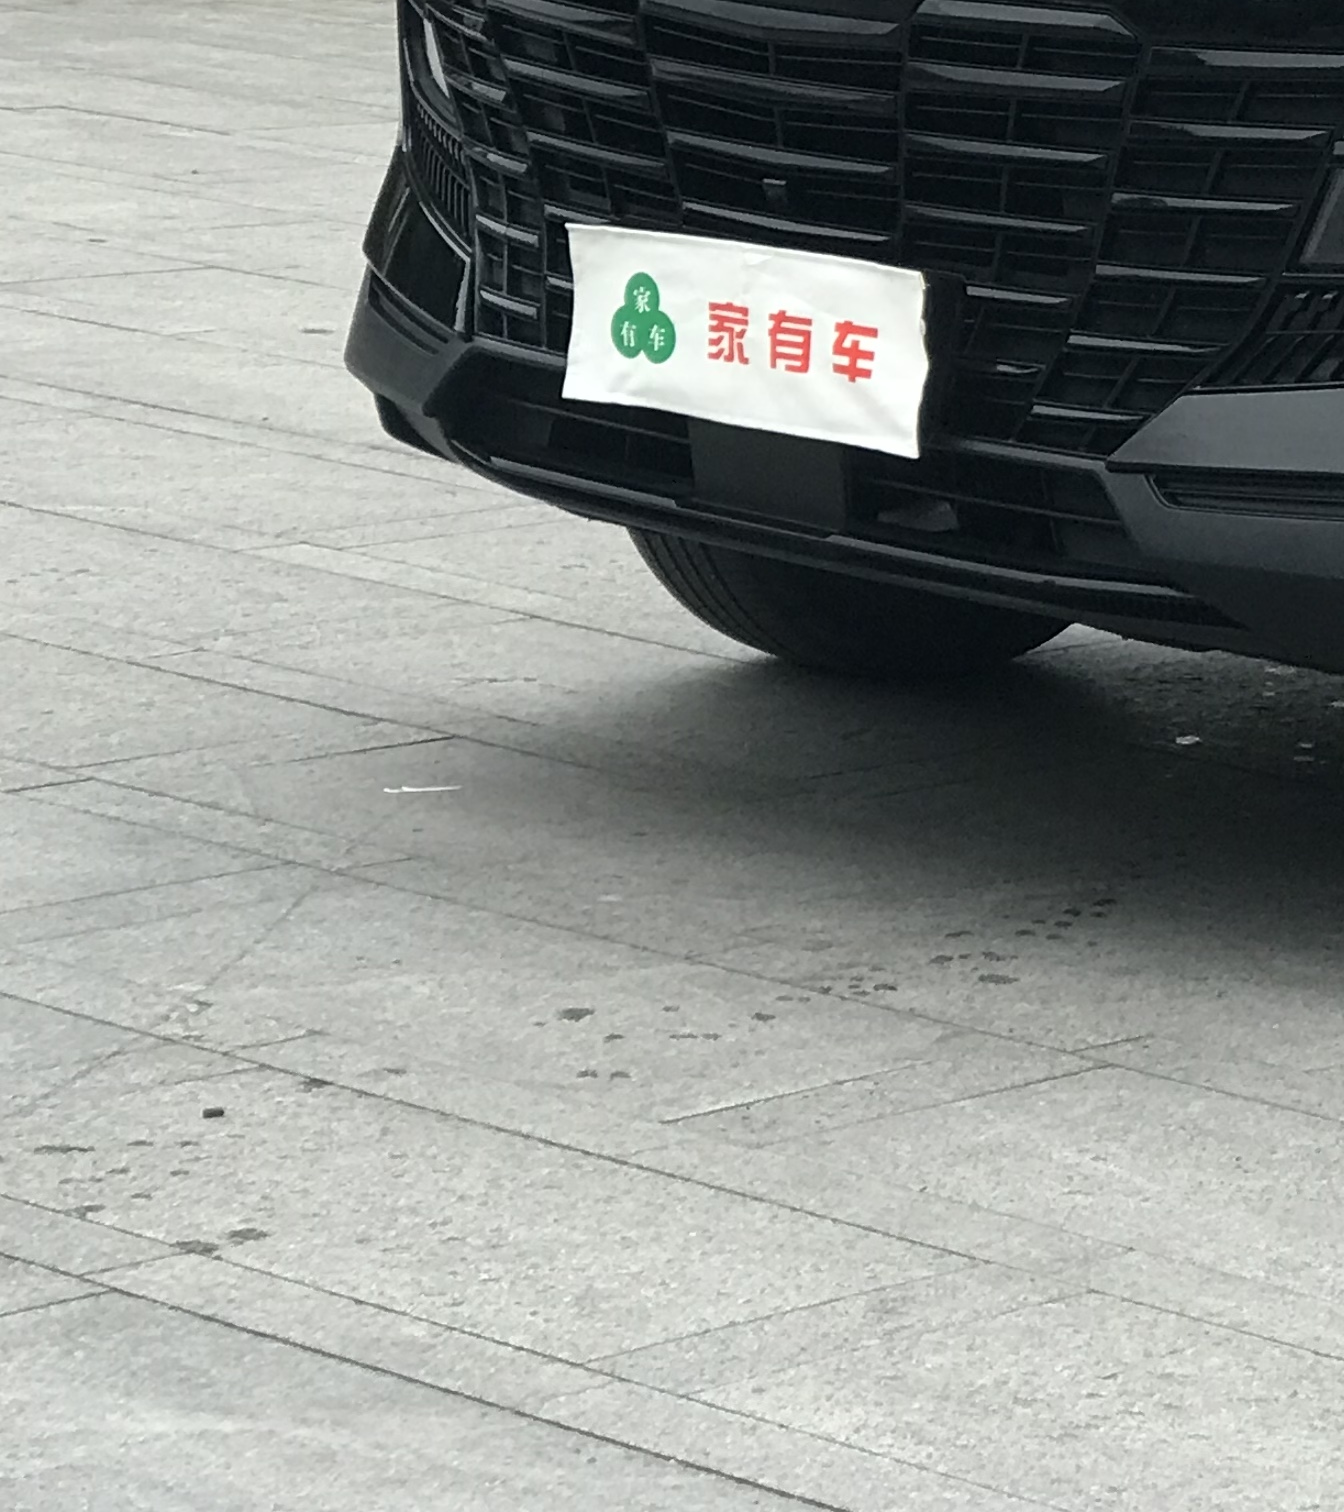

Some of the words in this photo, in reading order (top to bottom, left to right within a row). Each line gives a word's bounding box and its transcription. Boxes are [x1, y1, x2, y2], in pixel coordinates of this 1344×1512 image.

[632, 285, 652, 313] 家
[707, 301, 879, 383] 家有车
